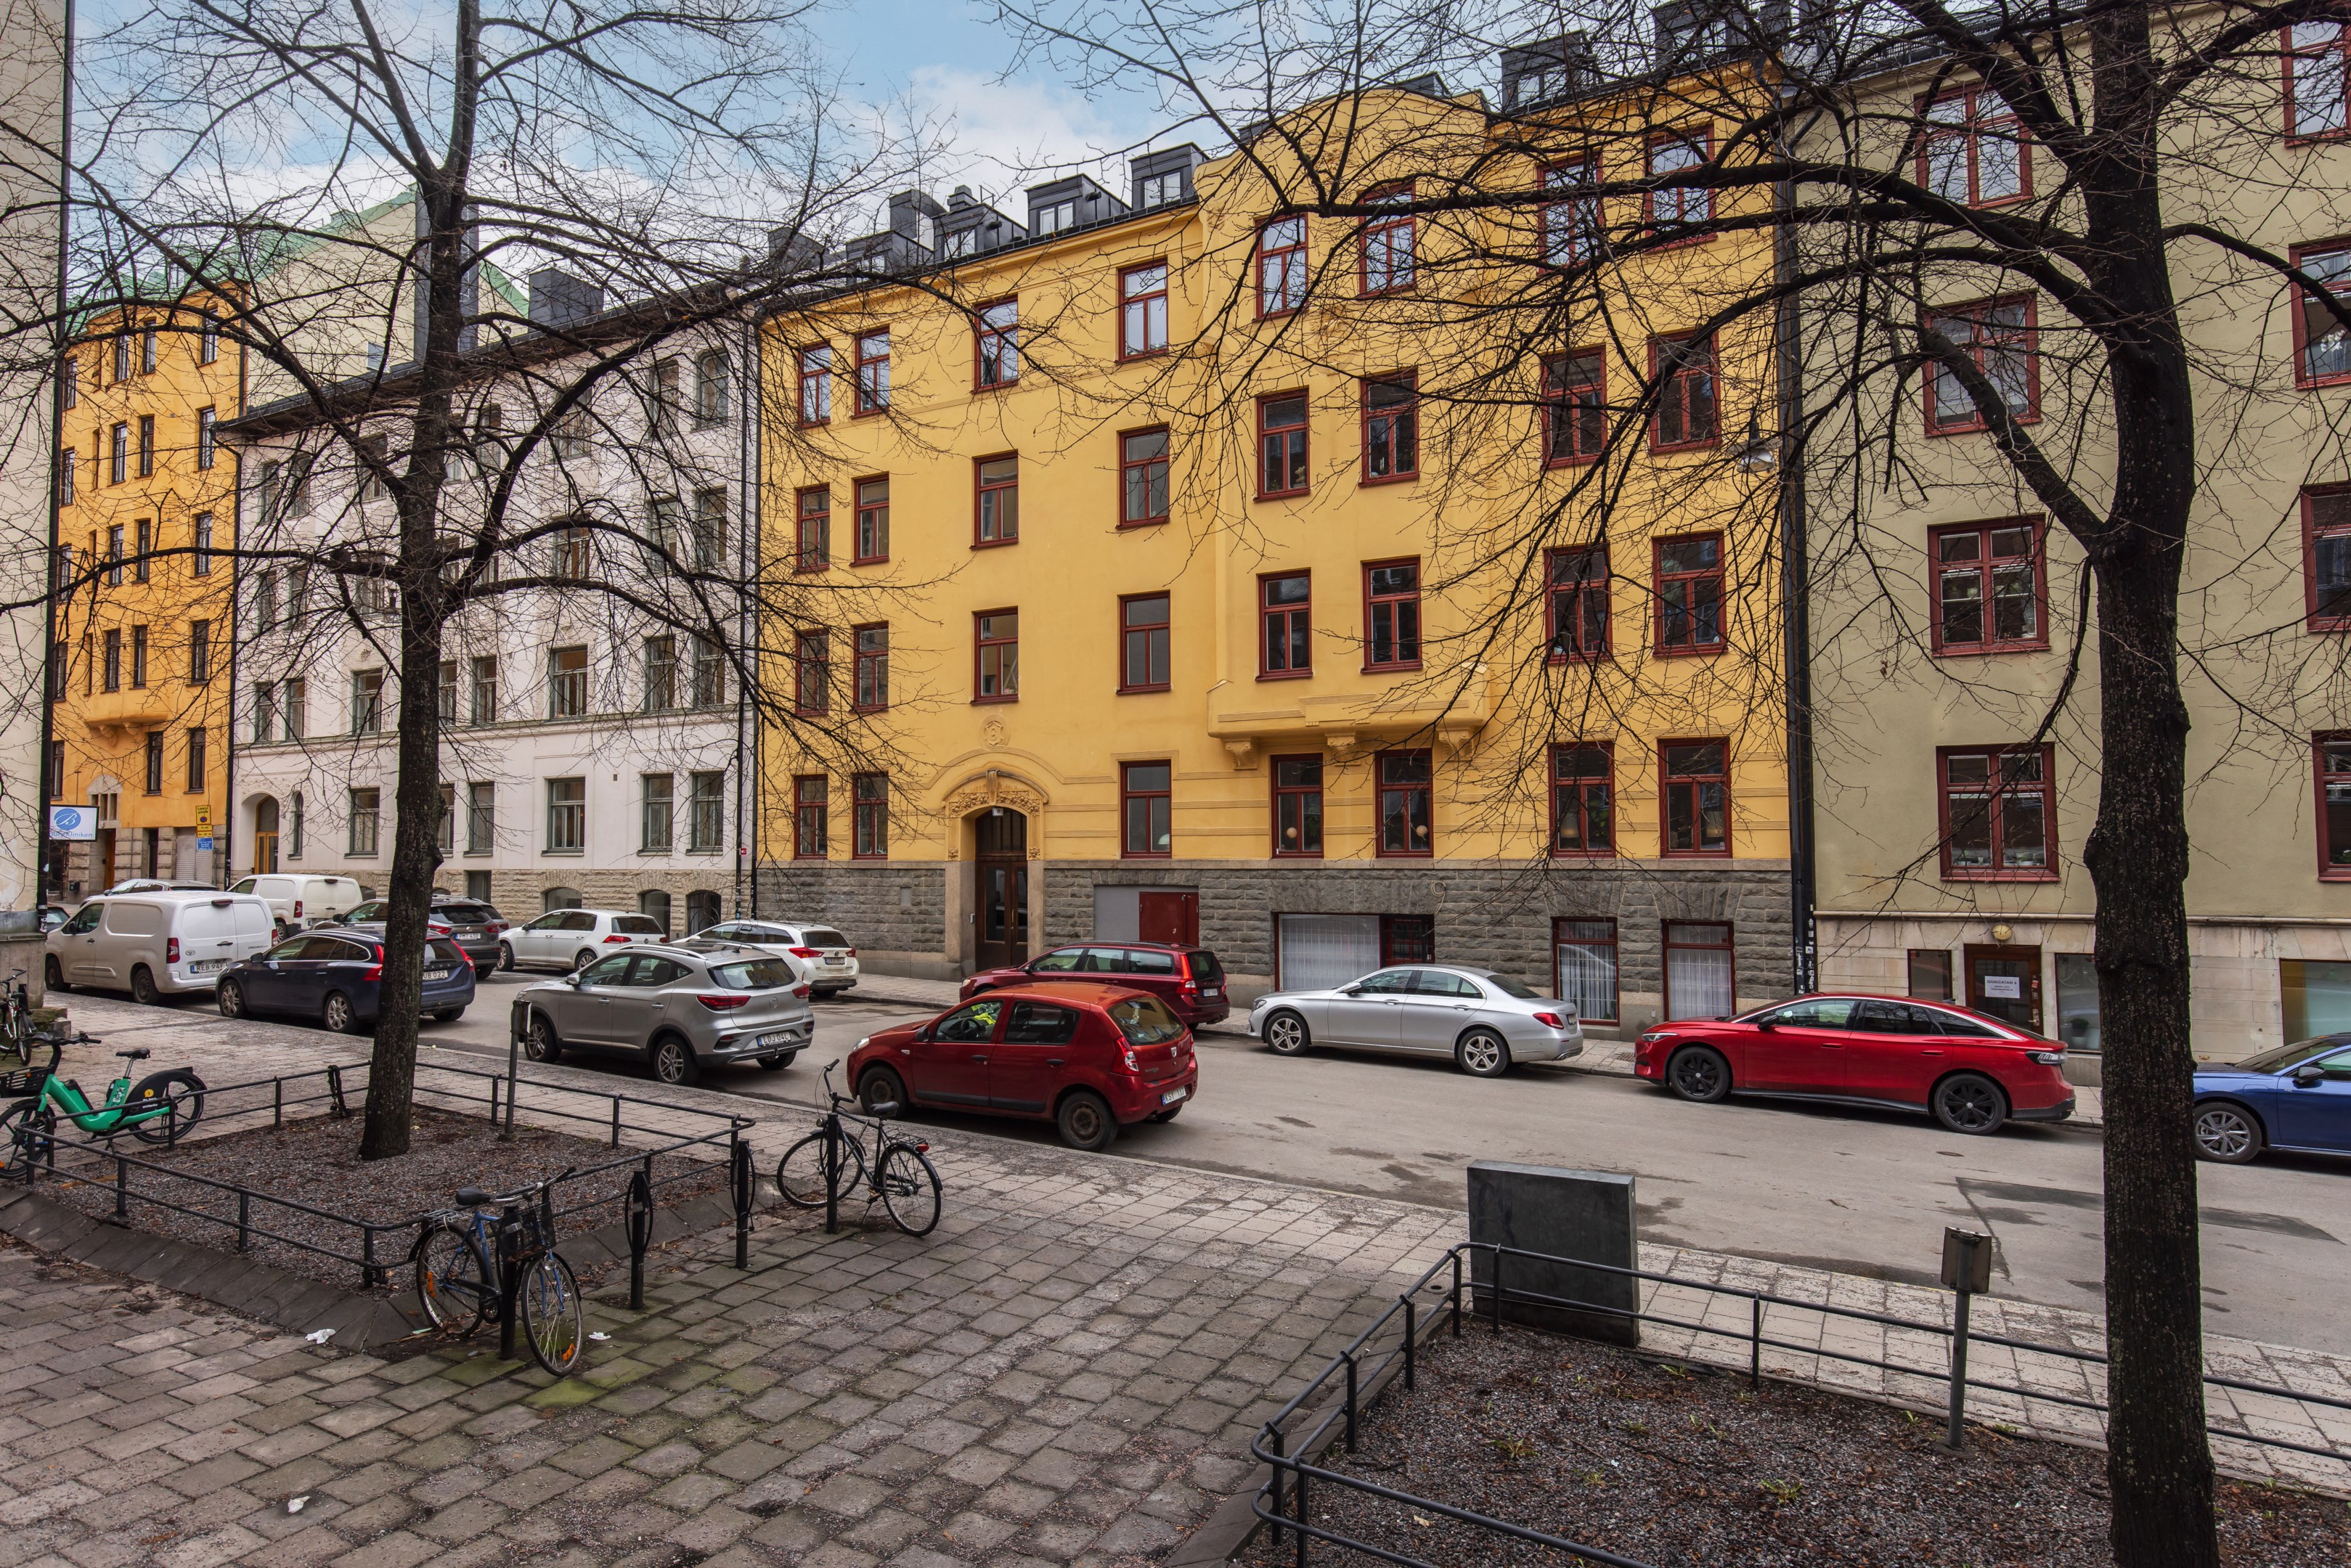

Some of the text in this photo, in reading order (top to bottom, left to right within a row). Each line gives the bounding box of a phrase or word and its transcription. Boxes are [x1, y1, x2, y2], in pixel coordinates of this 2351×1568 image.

[763, 1032, 789, 1043] LDJ 04L
[1165, 1090, 1176, 1102] KSY
